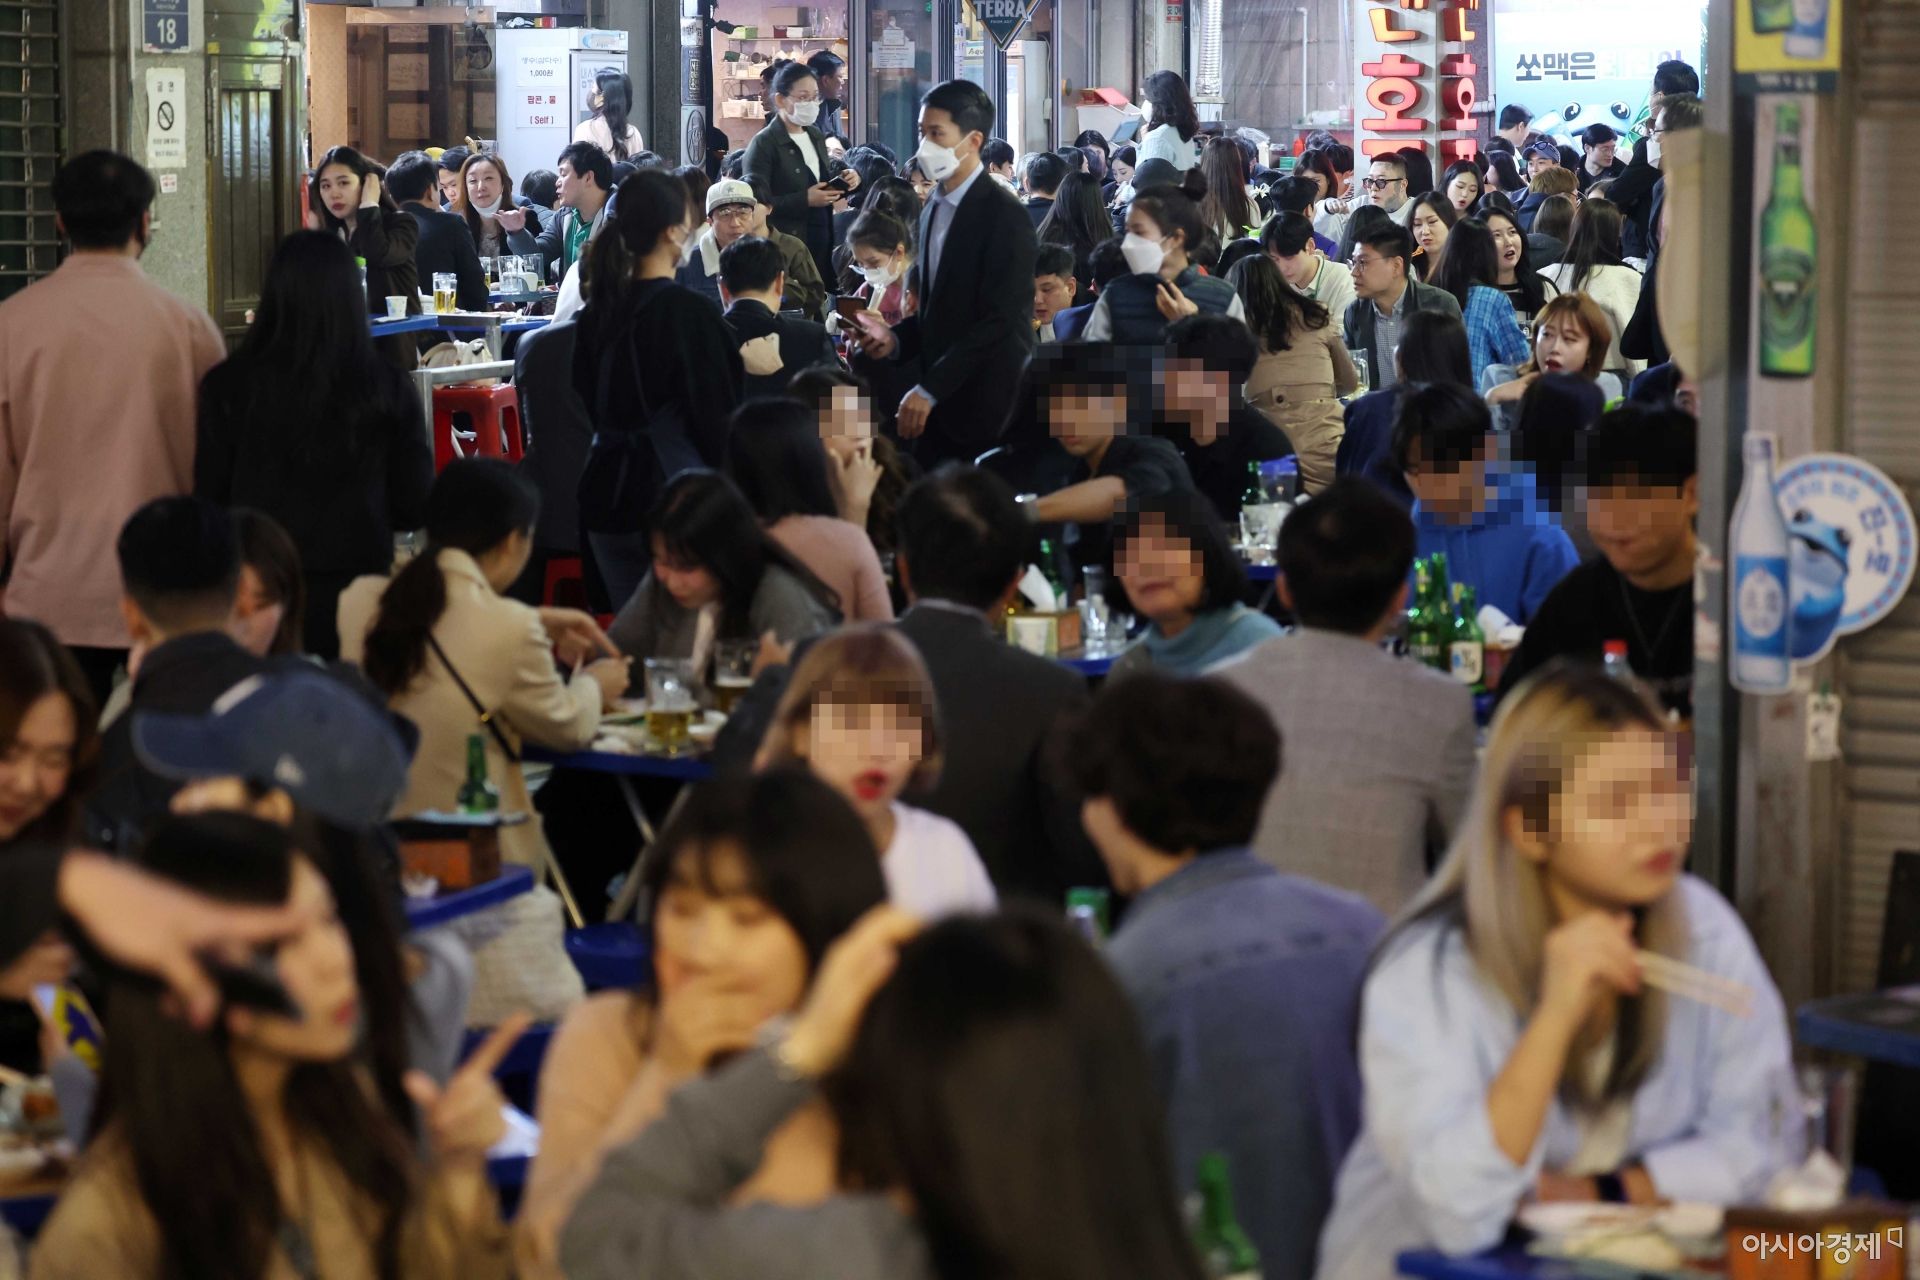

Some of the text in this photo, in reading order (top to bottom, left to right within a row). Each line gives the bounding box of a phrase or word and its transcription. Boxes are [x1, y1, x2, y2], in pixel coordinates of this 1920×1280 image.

[973, 0, 1028, 19] TERRA
[157, 18, 177, 44] 18
[1515, 51, 1596, 82] 쏘맥은
